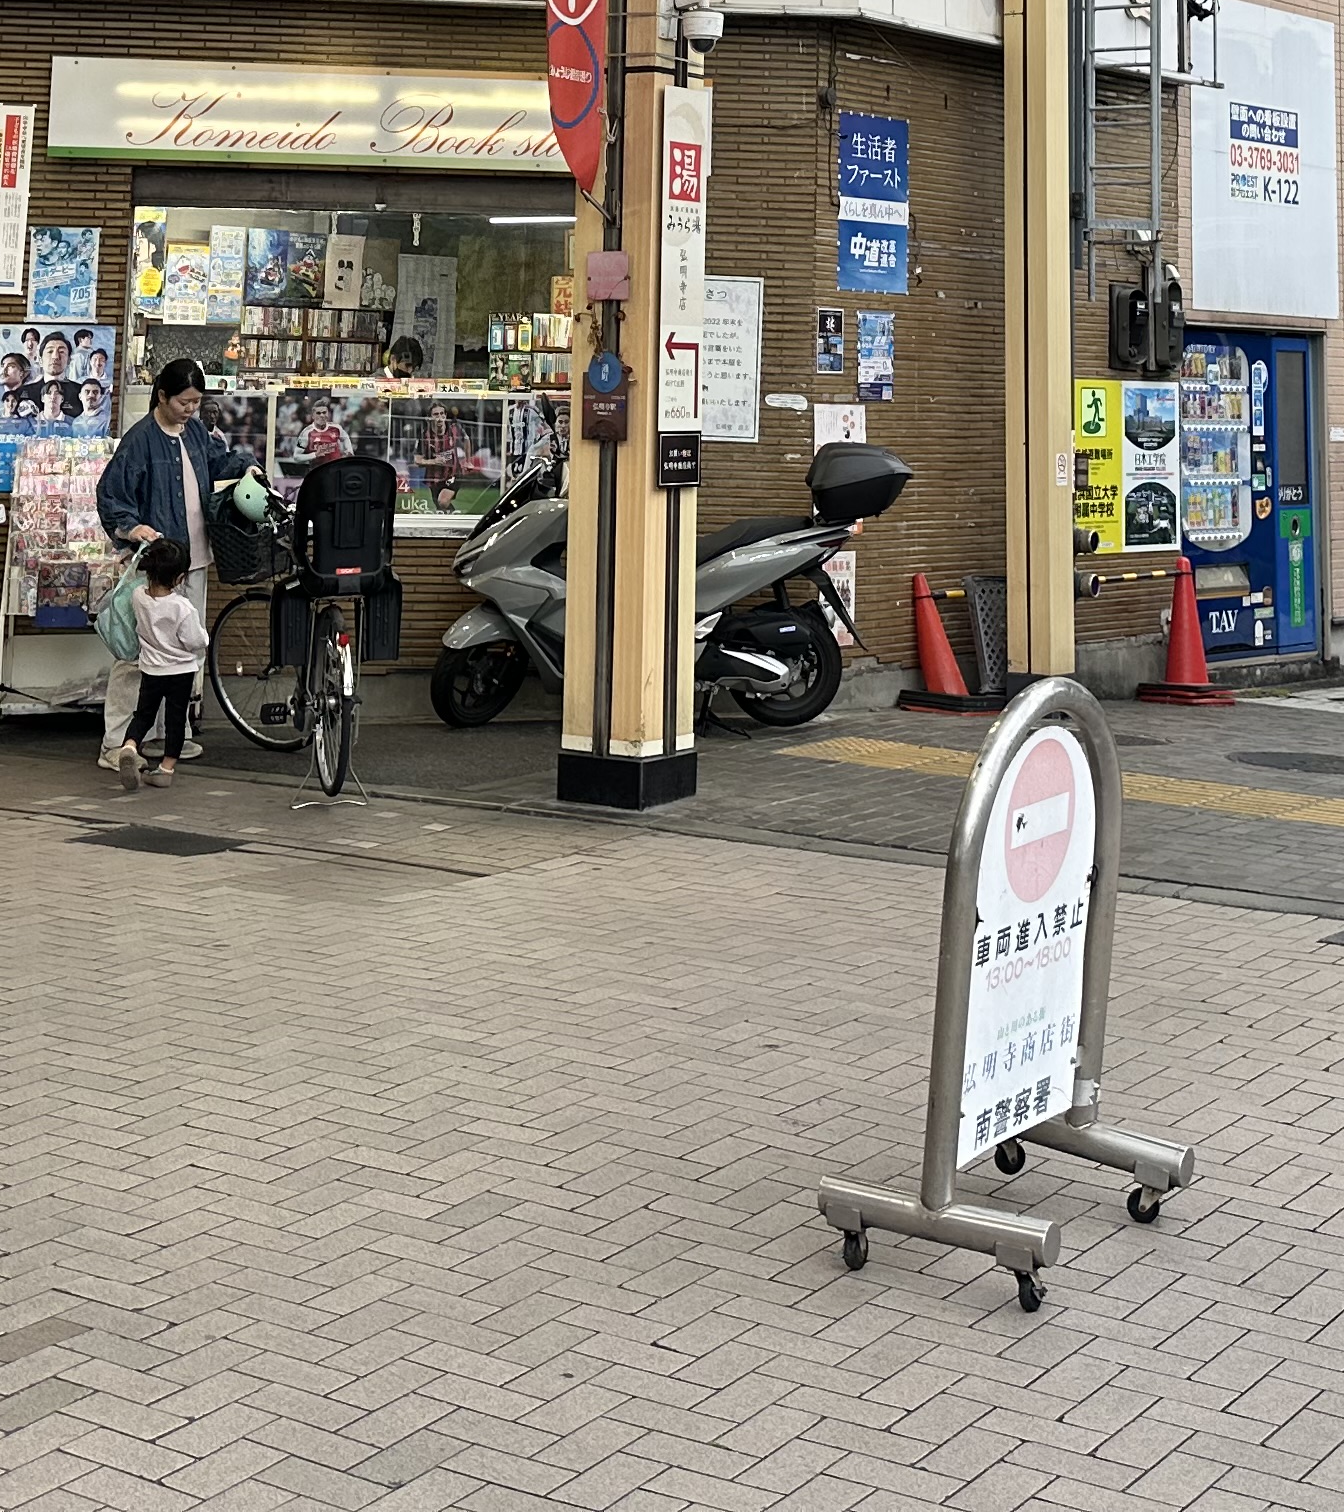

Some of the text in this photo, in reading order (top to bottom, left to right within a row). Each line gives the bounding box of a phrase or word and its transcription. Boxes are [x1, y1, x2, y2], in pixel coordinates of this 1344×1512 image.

[369, 93, 528, 156] Book
[1241, 123, 1286, 143] の問い合わせ
[851, 132, 898, 163] 生活者
[1230, 143, 1299, 175] 03-3769-3031
[672, 147, 698, 200] 湯
[846, 164, 902, 190] ファースト
[1263, 175, 1300, 205] K-122
[666, 214, 702, 235] みうら湯
[850, 232, 881, 267] 中道
[679, 248, 688, 311] 弘明寺店
[1134, 452, 1167, 467] 日本工学院
[400, 495, 429, 511] uka
[974, 897, 1086, 969] 車両進入禁止
[962, 1012, 1076, 1096] 弘明寺商店街
[973, 1075, 1052, 1152] 南警察署
